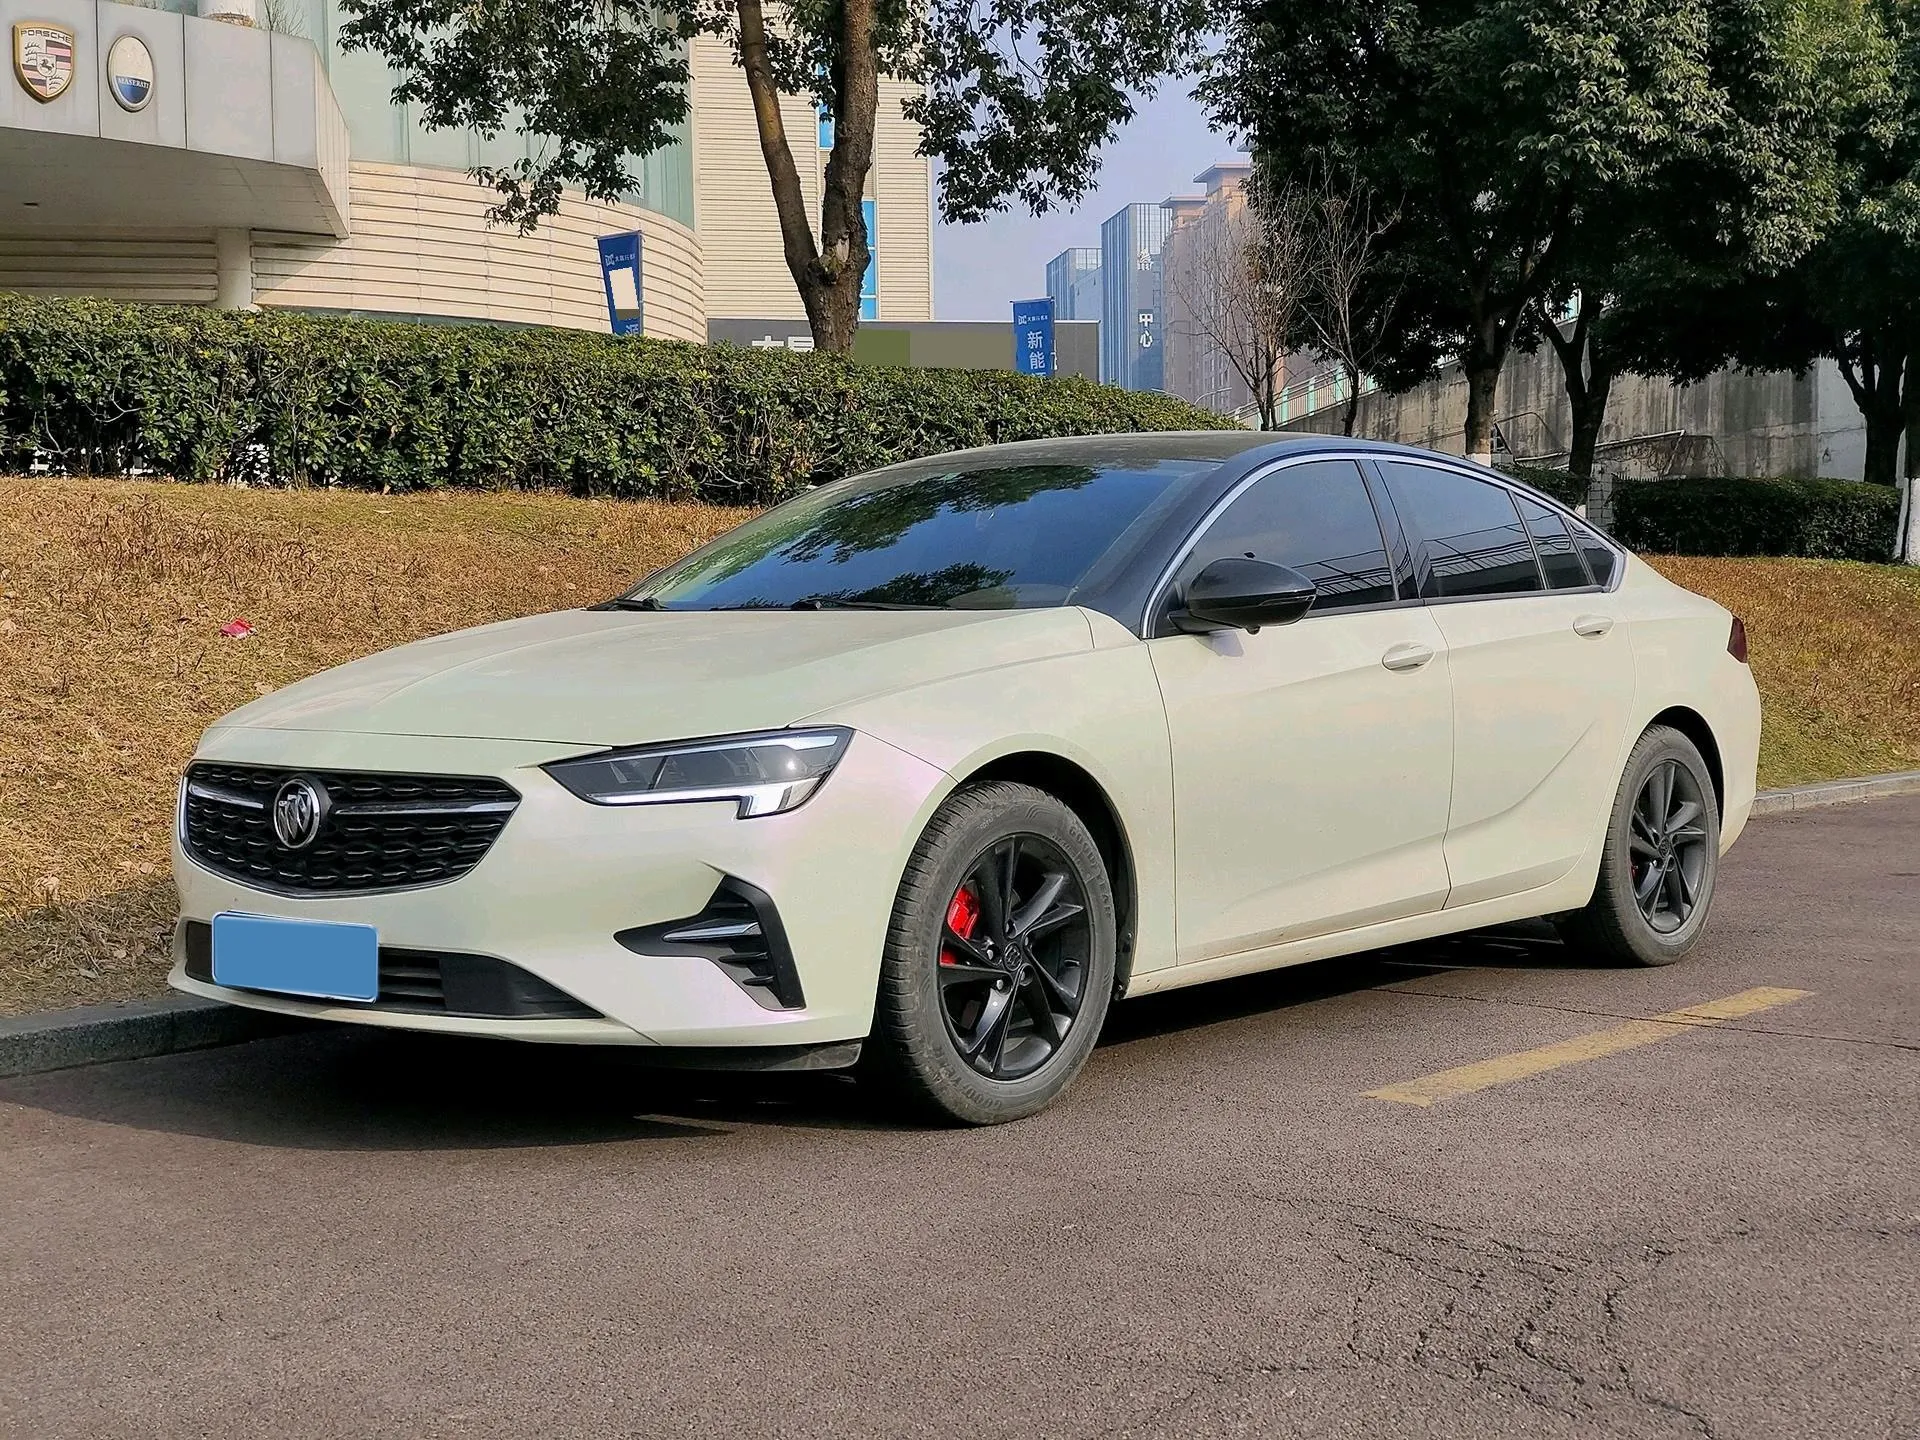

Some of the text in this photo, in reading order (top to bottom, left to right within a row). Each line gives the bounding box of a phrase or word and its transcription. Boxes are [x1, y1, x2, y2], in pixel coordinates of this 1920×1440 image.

[20, 29, 73, 44] PORSCHE
[117, 77, 150, 89] MASERATI
[1027, 330, 1047, 377] 新能
